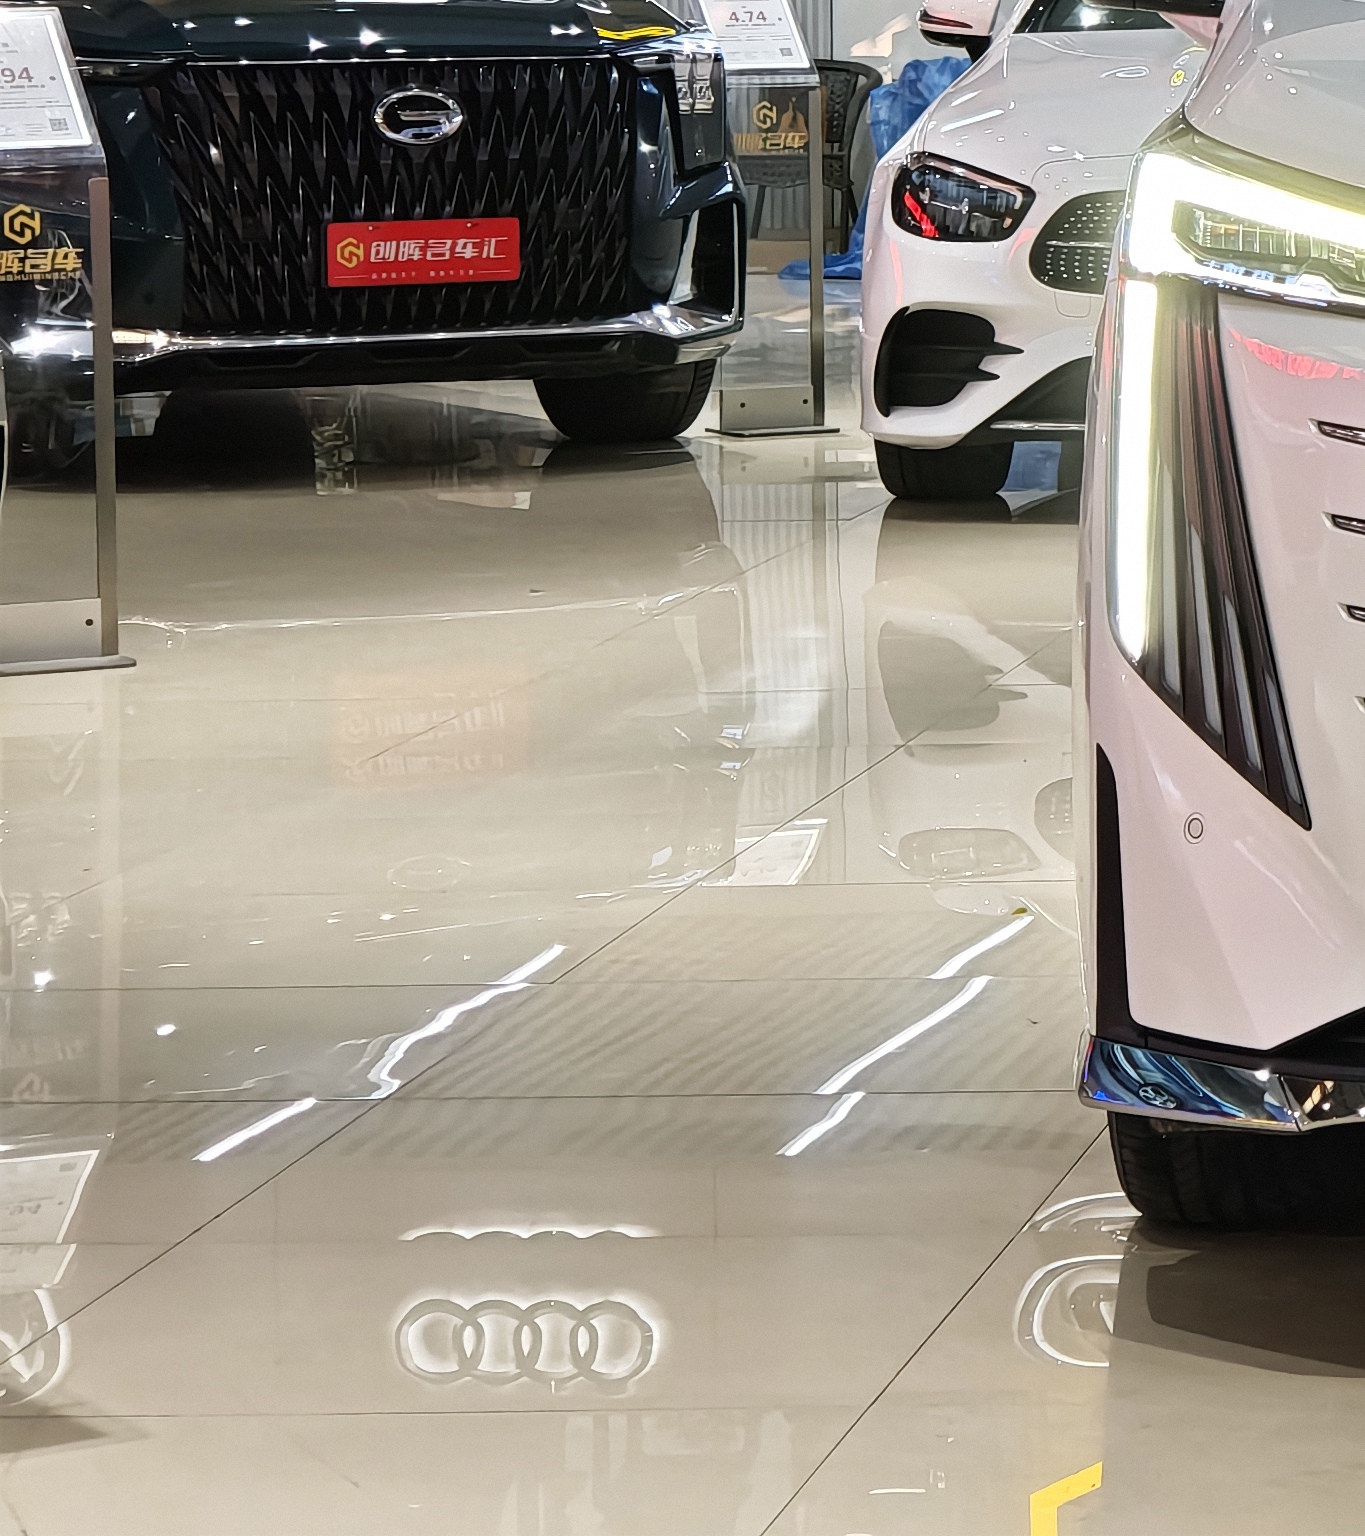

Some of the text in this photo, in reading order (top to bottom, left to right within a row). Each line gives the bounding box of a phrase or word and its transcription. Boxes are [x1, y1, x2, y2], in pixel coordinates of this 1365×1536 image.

[729, 11, 767, 23] 4.74
[369, 237, 509, 263] 创晖名车汇
